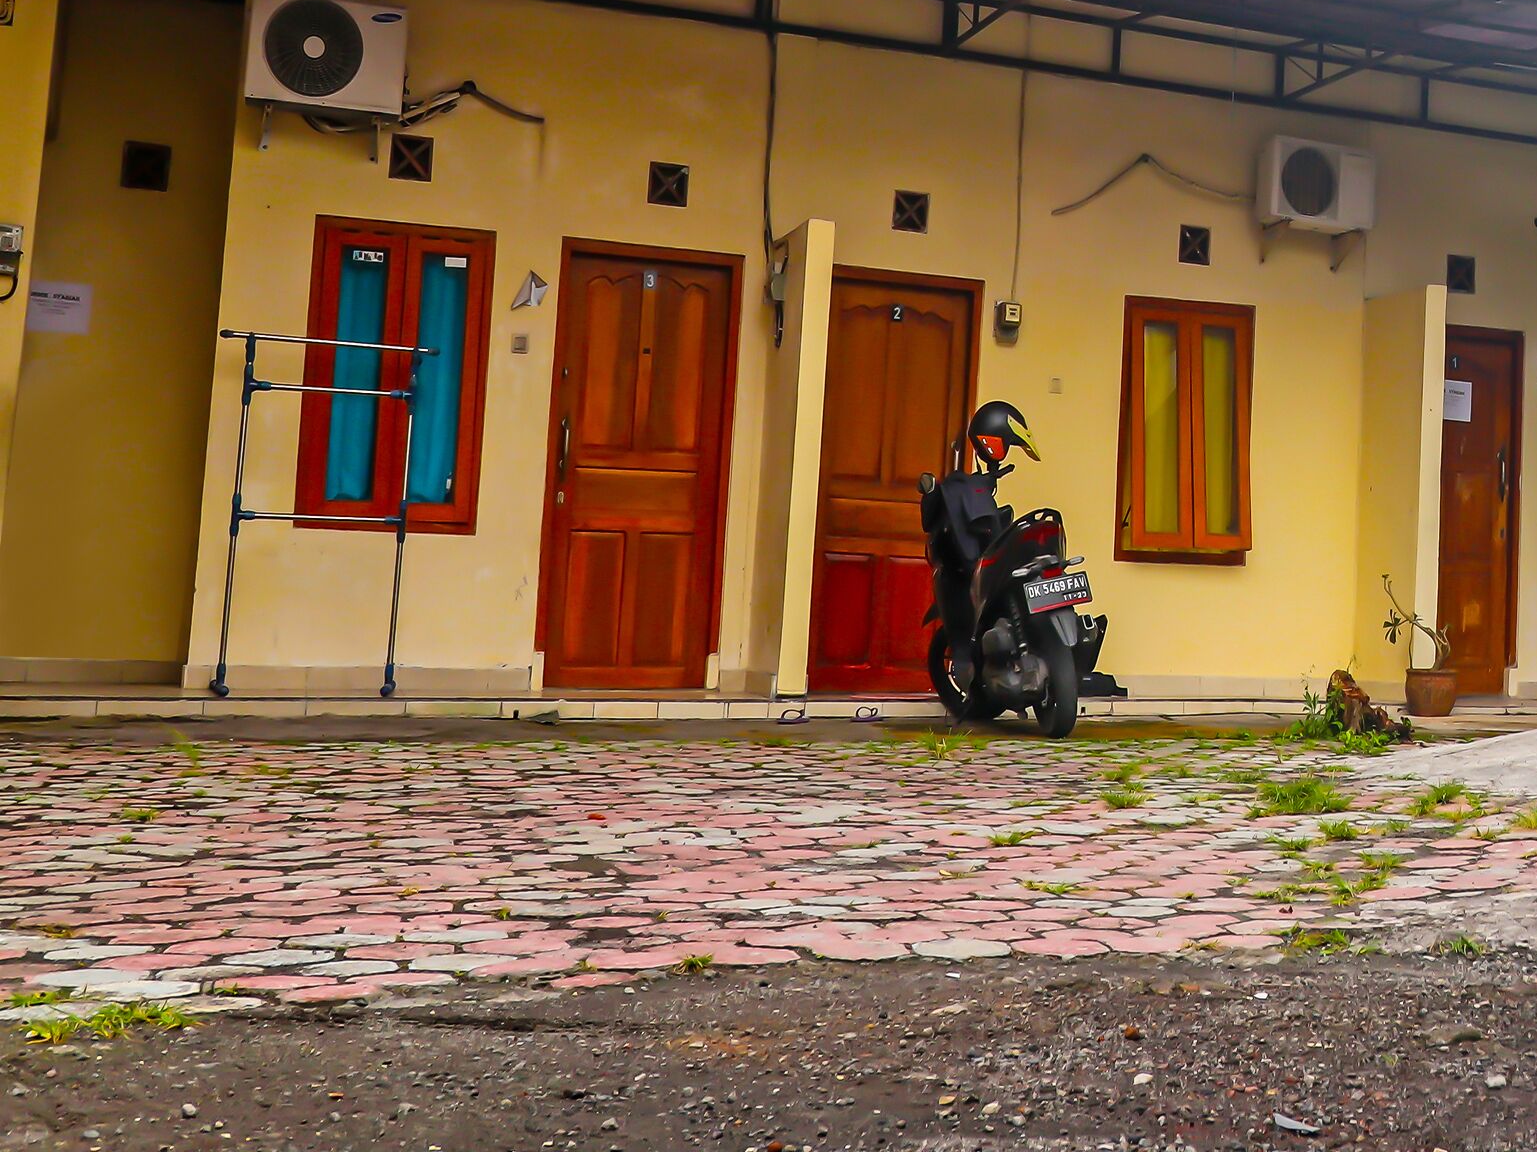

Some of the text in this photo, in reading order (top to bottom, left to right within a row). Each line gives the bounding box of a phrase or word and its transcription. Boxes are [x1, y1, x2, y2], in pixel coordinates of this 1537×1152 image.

[646, 274, 655, 288] 3
[893, 307, 901, 319] 2
[1028, 577, 1085, 598] DK 5469 FAV
